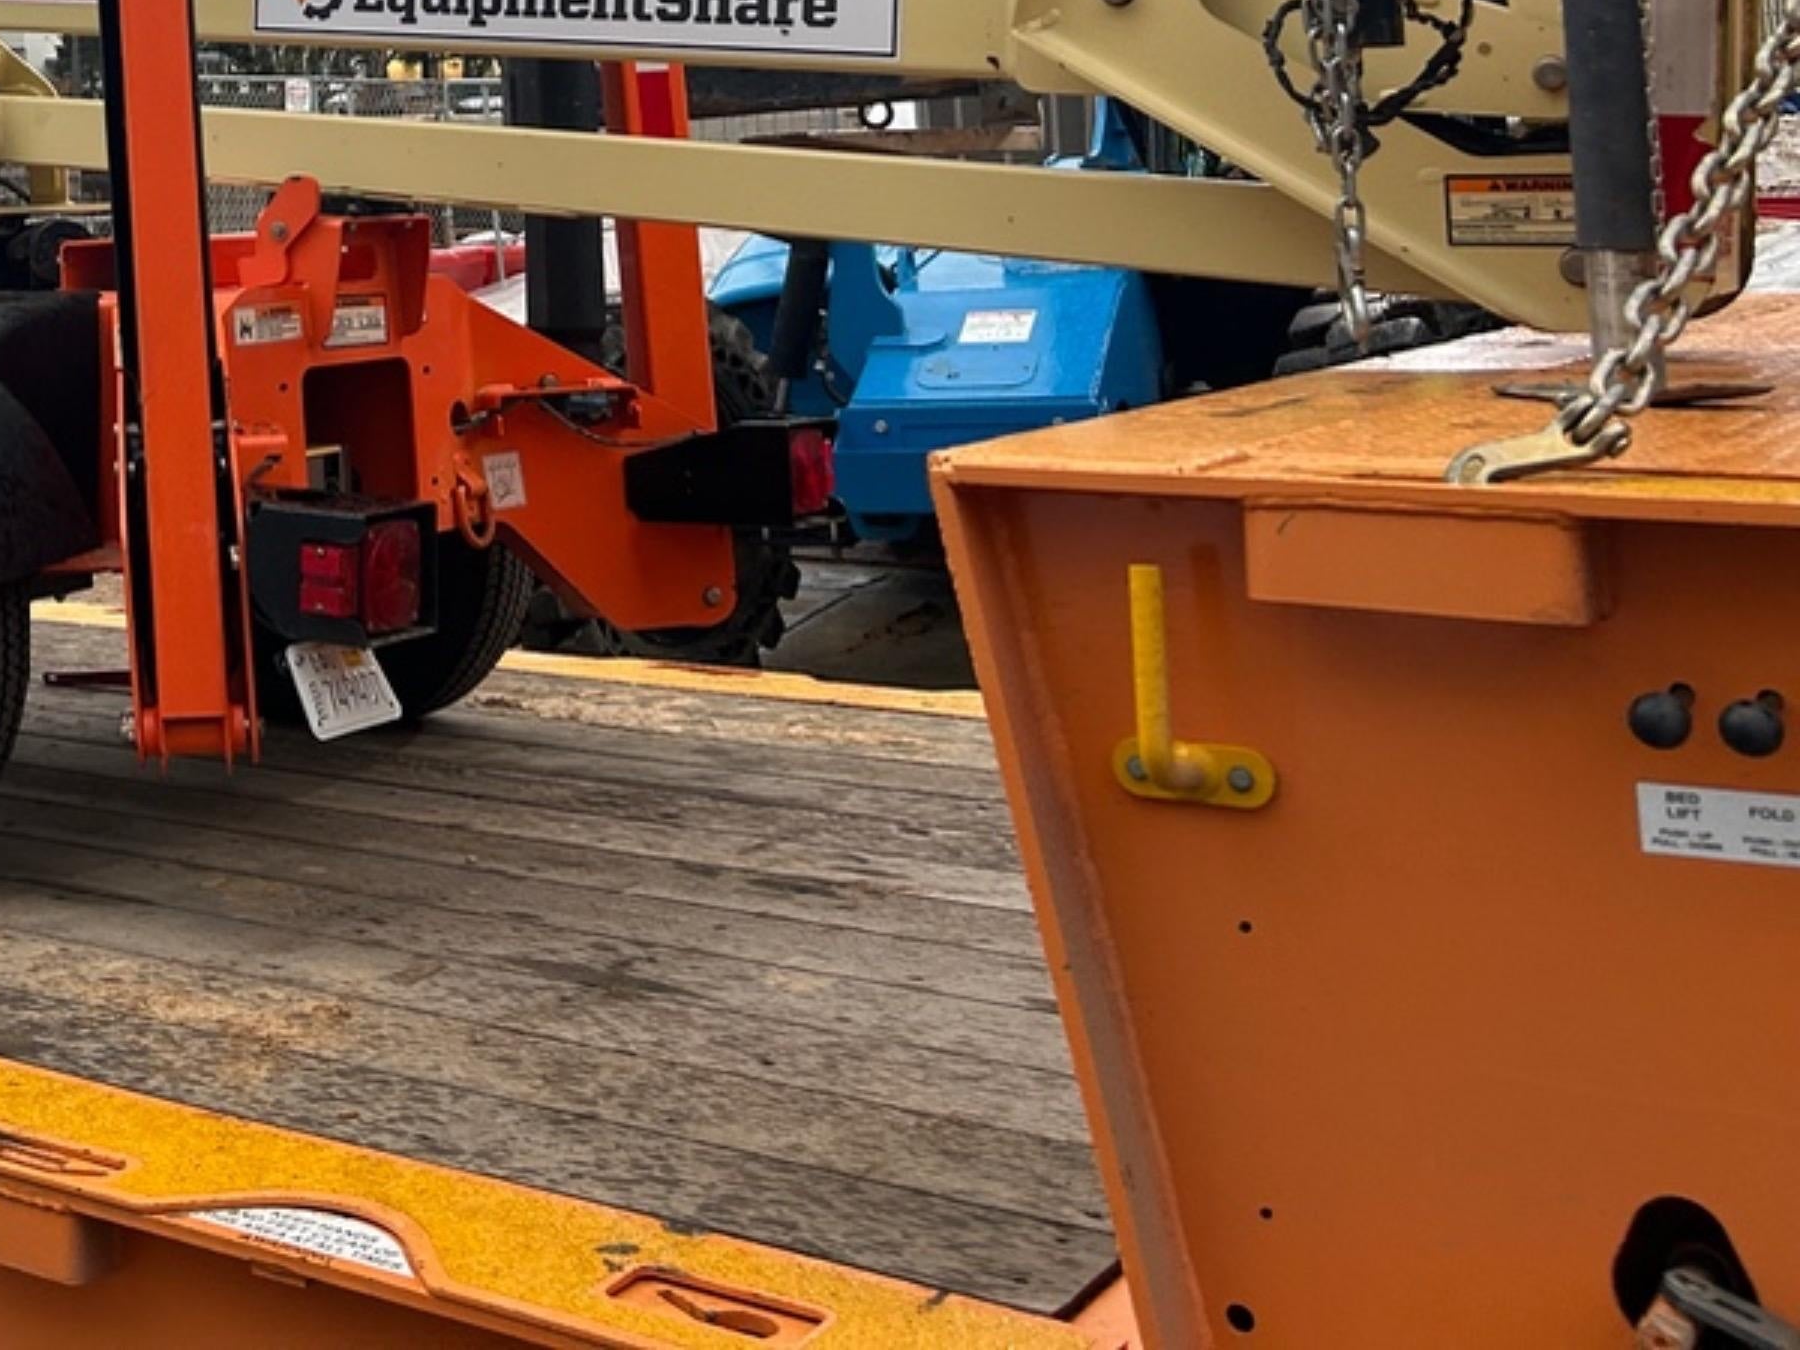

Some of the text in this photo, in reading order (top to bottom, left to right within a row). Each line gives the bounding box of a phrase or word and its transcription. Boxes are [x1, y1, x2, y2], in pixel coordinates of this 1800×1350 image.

[1504, 178, 1574, 192] WARNIN
[1664, 791, 1702, 804] BED
[1666, 807, 1703, 821] LIFT
[1748, 806, 1795, 822] FOLD
